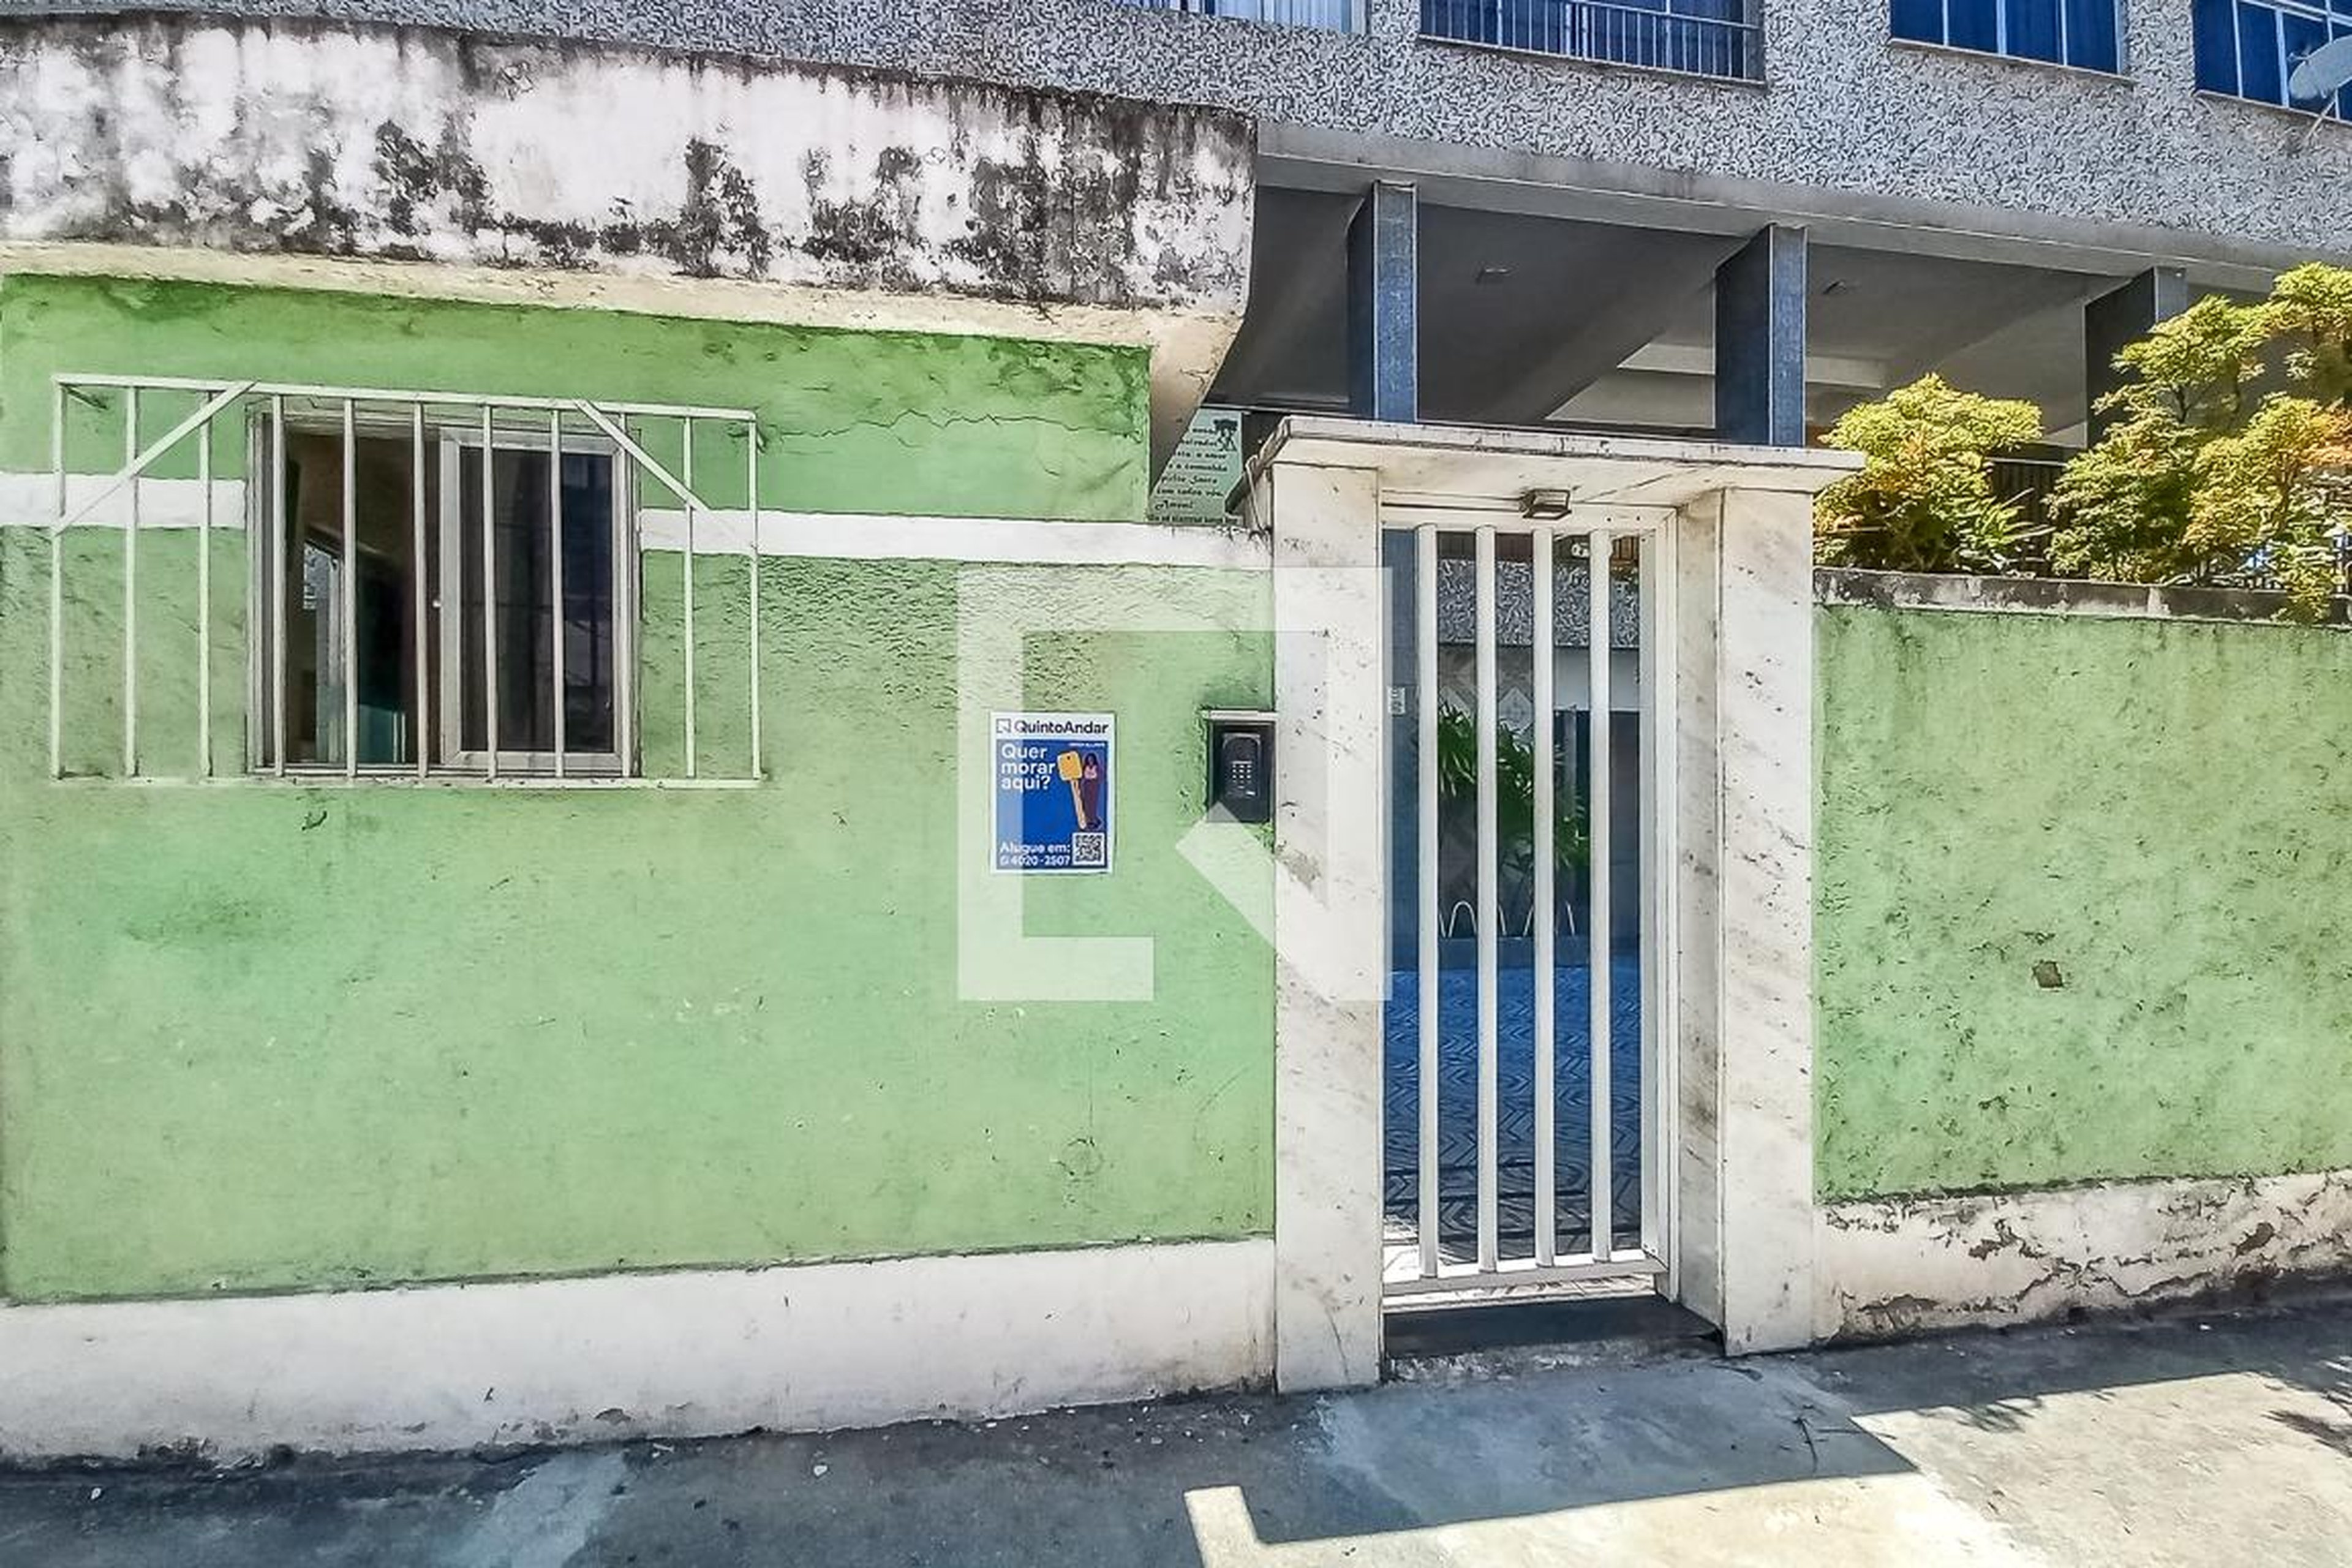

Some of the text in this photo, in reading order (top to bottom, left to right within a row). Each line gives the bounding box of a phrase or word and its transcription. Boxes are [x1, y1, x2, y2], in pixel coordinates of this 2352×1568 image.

[1014, 720, 1109, 734] QuintoAndar
[1001, 744, 1047, 760] Quer
[1001, 761, 1056, 775] morar
[1001, 775, 1051, 793] aqui?
[1000, 842, 1071, 854] Alugue em:
